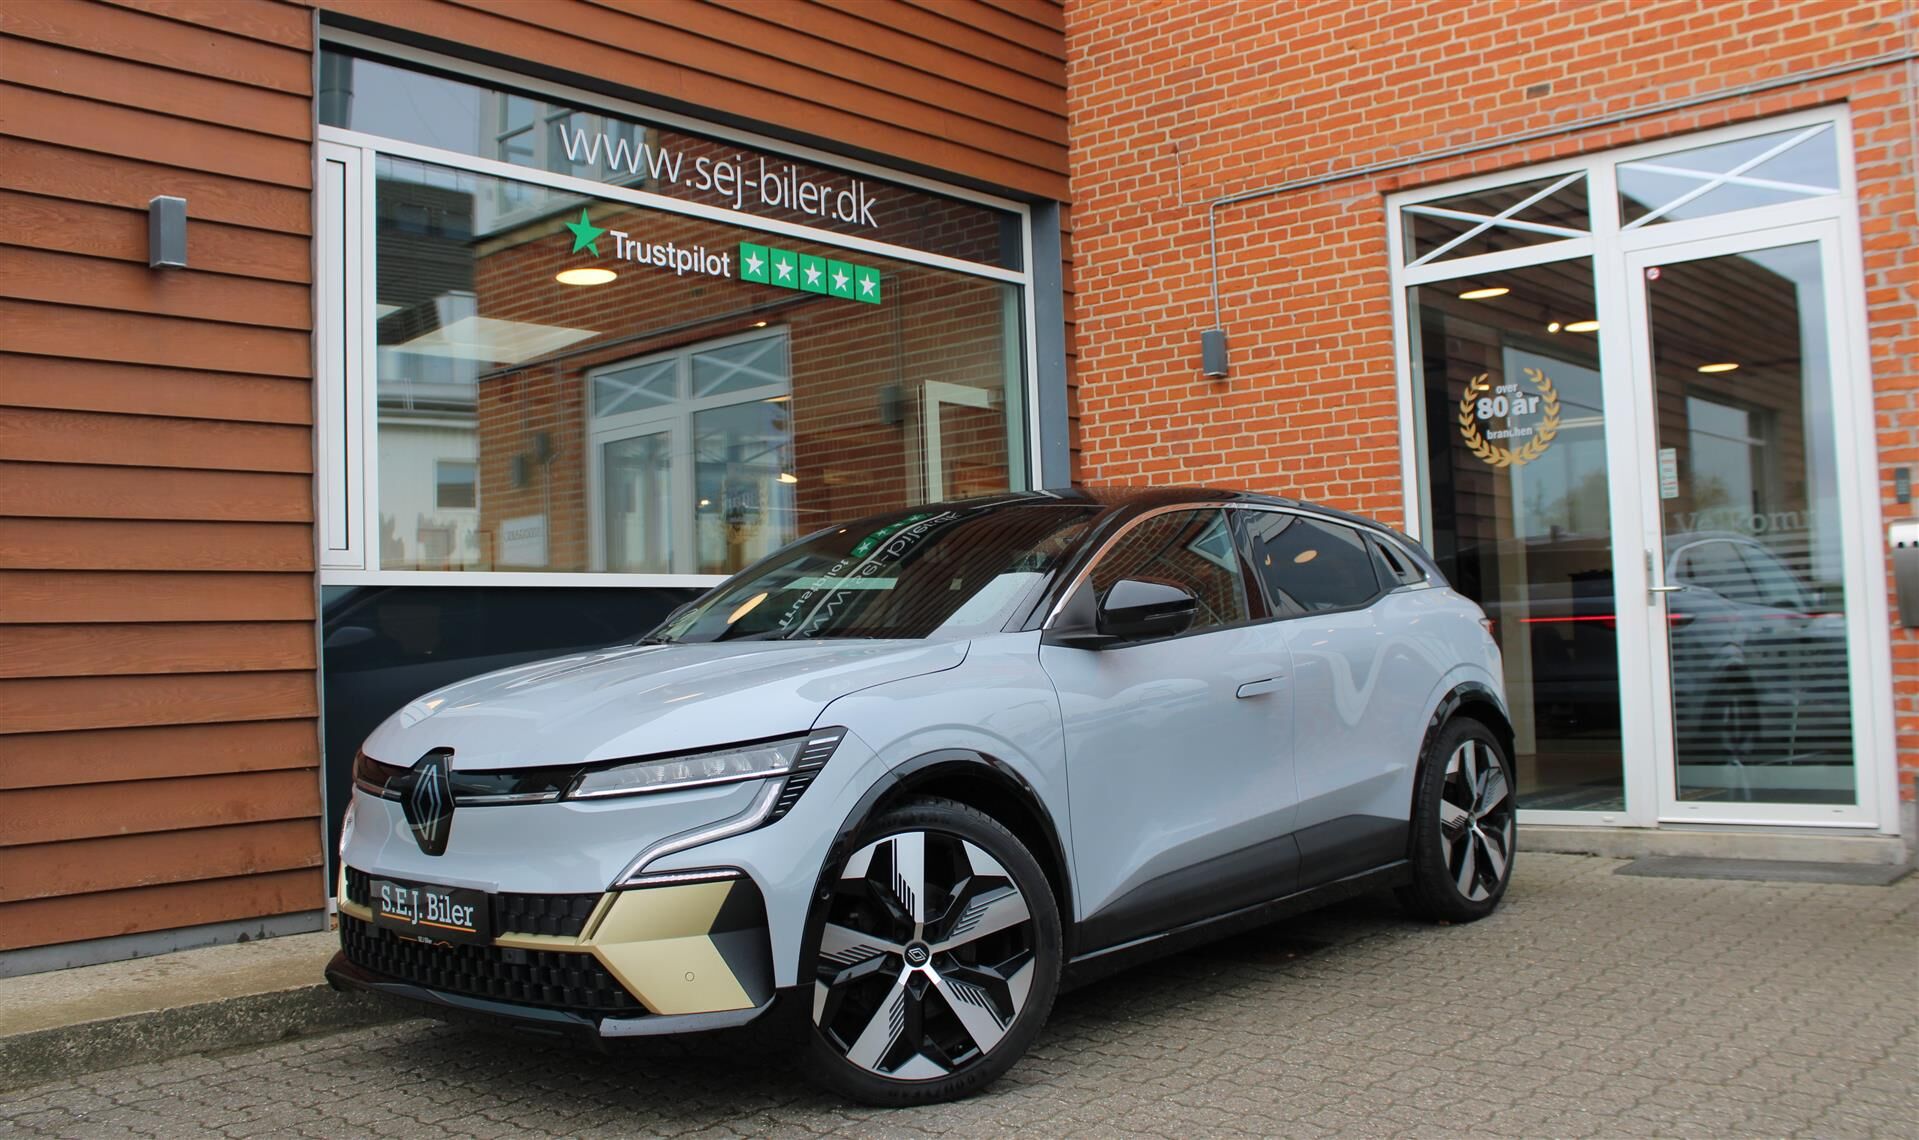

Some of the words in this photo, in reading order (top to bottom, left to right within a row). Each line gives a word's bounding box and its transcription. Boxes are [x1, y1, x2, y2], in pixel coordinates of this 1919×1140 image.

[560, 124, 878, 228] www.sej-biler.dk
[609, 230, 731, 278] Trustpilot
[1477, 395, 1509, 420] 80
[1512, 391, 1539, 416] år
[1495, 384, 1518, 394] over
[381, 885, 423, 925] S.E.J.
[426, 893, 474, 927] Biler
